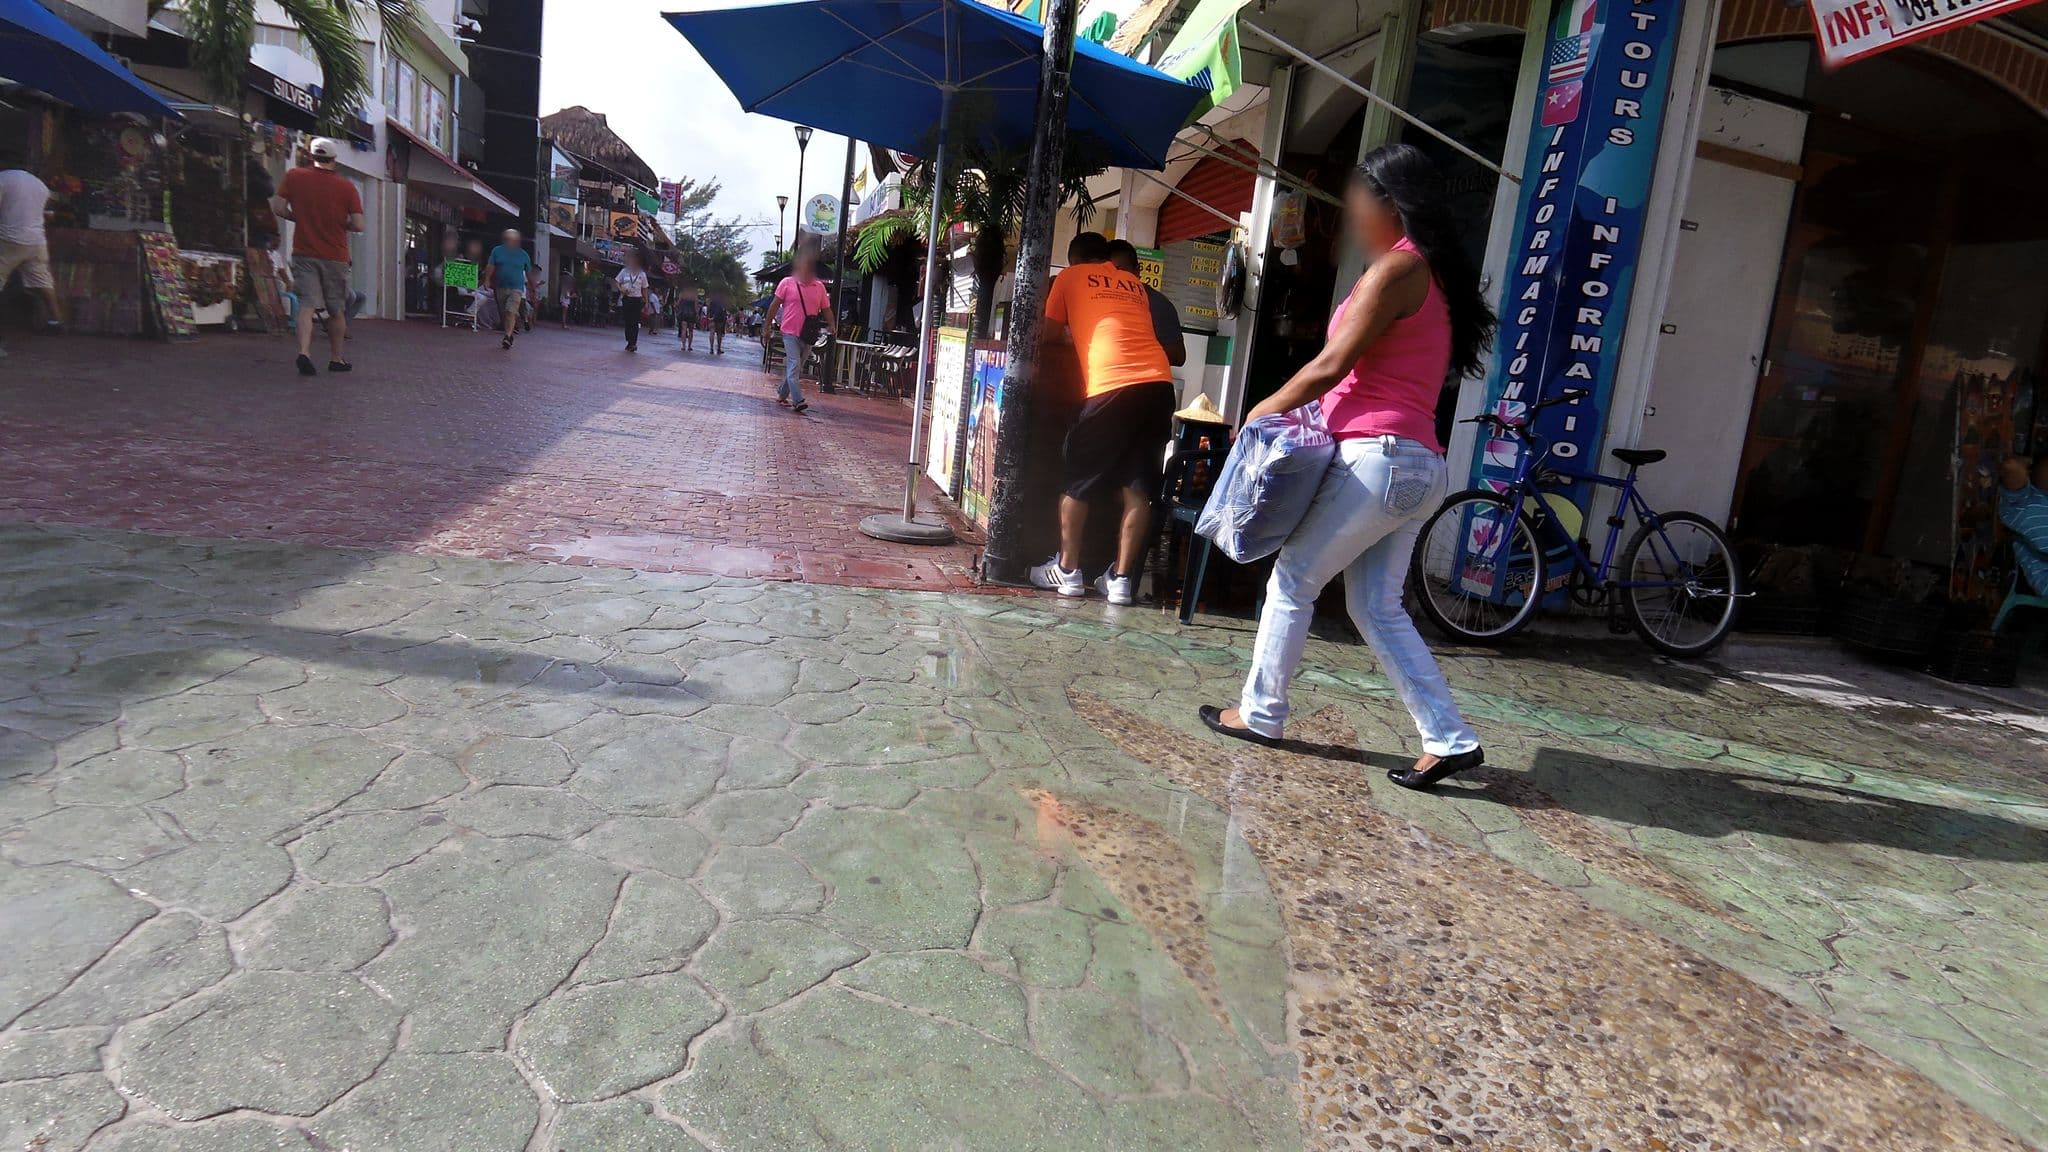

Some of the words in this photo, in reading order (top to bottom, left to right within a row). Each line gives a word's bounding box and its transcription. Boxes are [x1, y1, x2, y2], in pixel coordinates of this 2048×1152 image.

[273, 79, 313, 112] SILVER
[1608, 12, 1656, 146] TOURS
[1503, 126, 1565, 400] INFORMACIÓN
